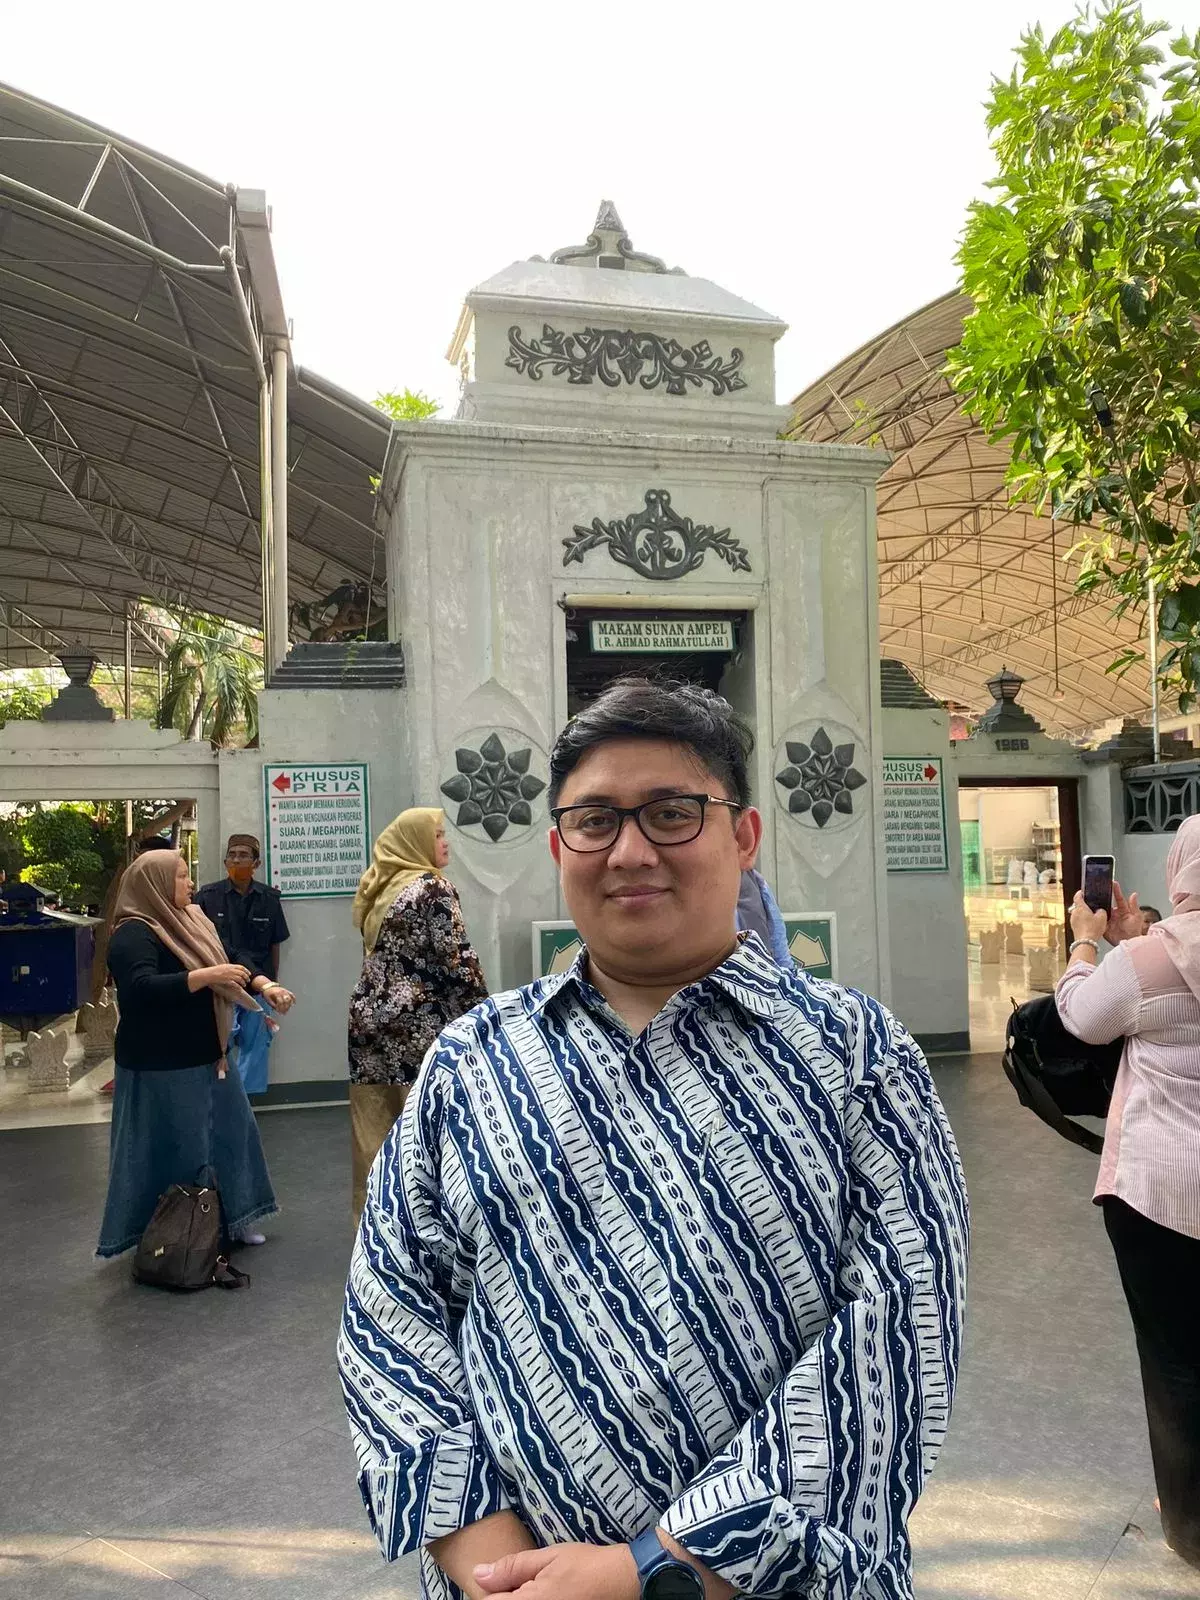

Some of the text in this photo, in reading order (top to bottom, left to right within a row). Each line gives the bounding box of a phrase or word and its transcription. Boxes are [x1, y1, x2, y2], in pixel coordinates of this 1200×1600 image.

[598, 622, 727, 635] MAKAM SUNAN AMPEL
[616, 637, 650, 647] AHMAD
[883, 763, 922, 772] HUSUS
[293, 770, 360, 782] KHUSUS
[883, 773, 923, 782] ANITA
[279, 813, 303, 823] DILARANG
[338, 811, 362, 821] PENGERAS
[884, 811, 899, 819] UARA
[279, 826, 305, 837] SUARA
[312, 825, 362, 836] MEGAPHONE.
[884, 822, 900, 831] LARANG
[885, 834, 905, 843] EMOTRET
[280, 840, 306, 850] DILARANG
[307, 839, 338, 849] MENGAMBIL
[280, 853, 313, 864] MEMOTRET
[314, 853, 322, 862] DI
[323, 852, 338, 862] AREA
[281, 880, 305, 891] DILARANG
[306, 879, 324, 890] SHOLAT
[331, 878, 344, 889] AREA
